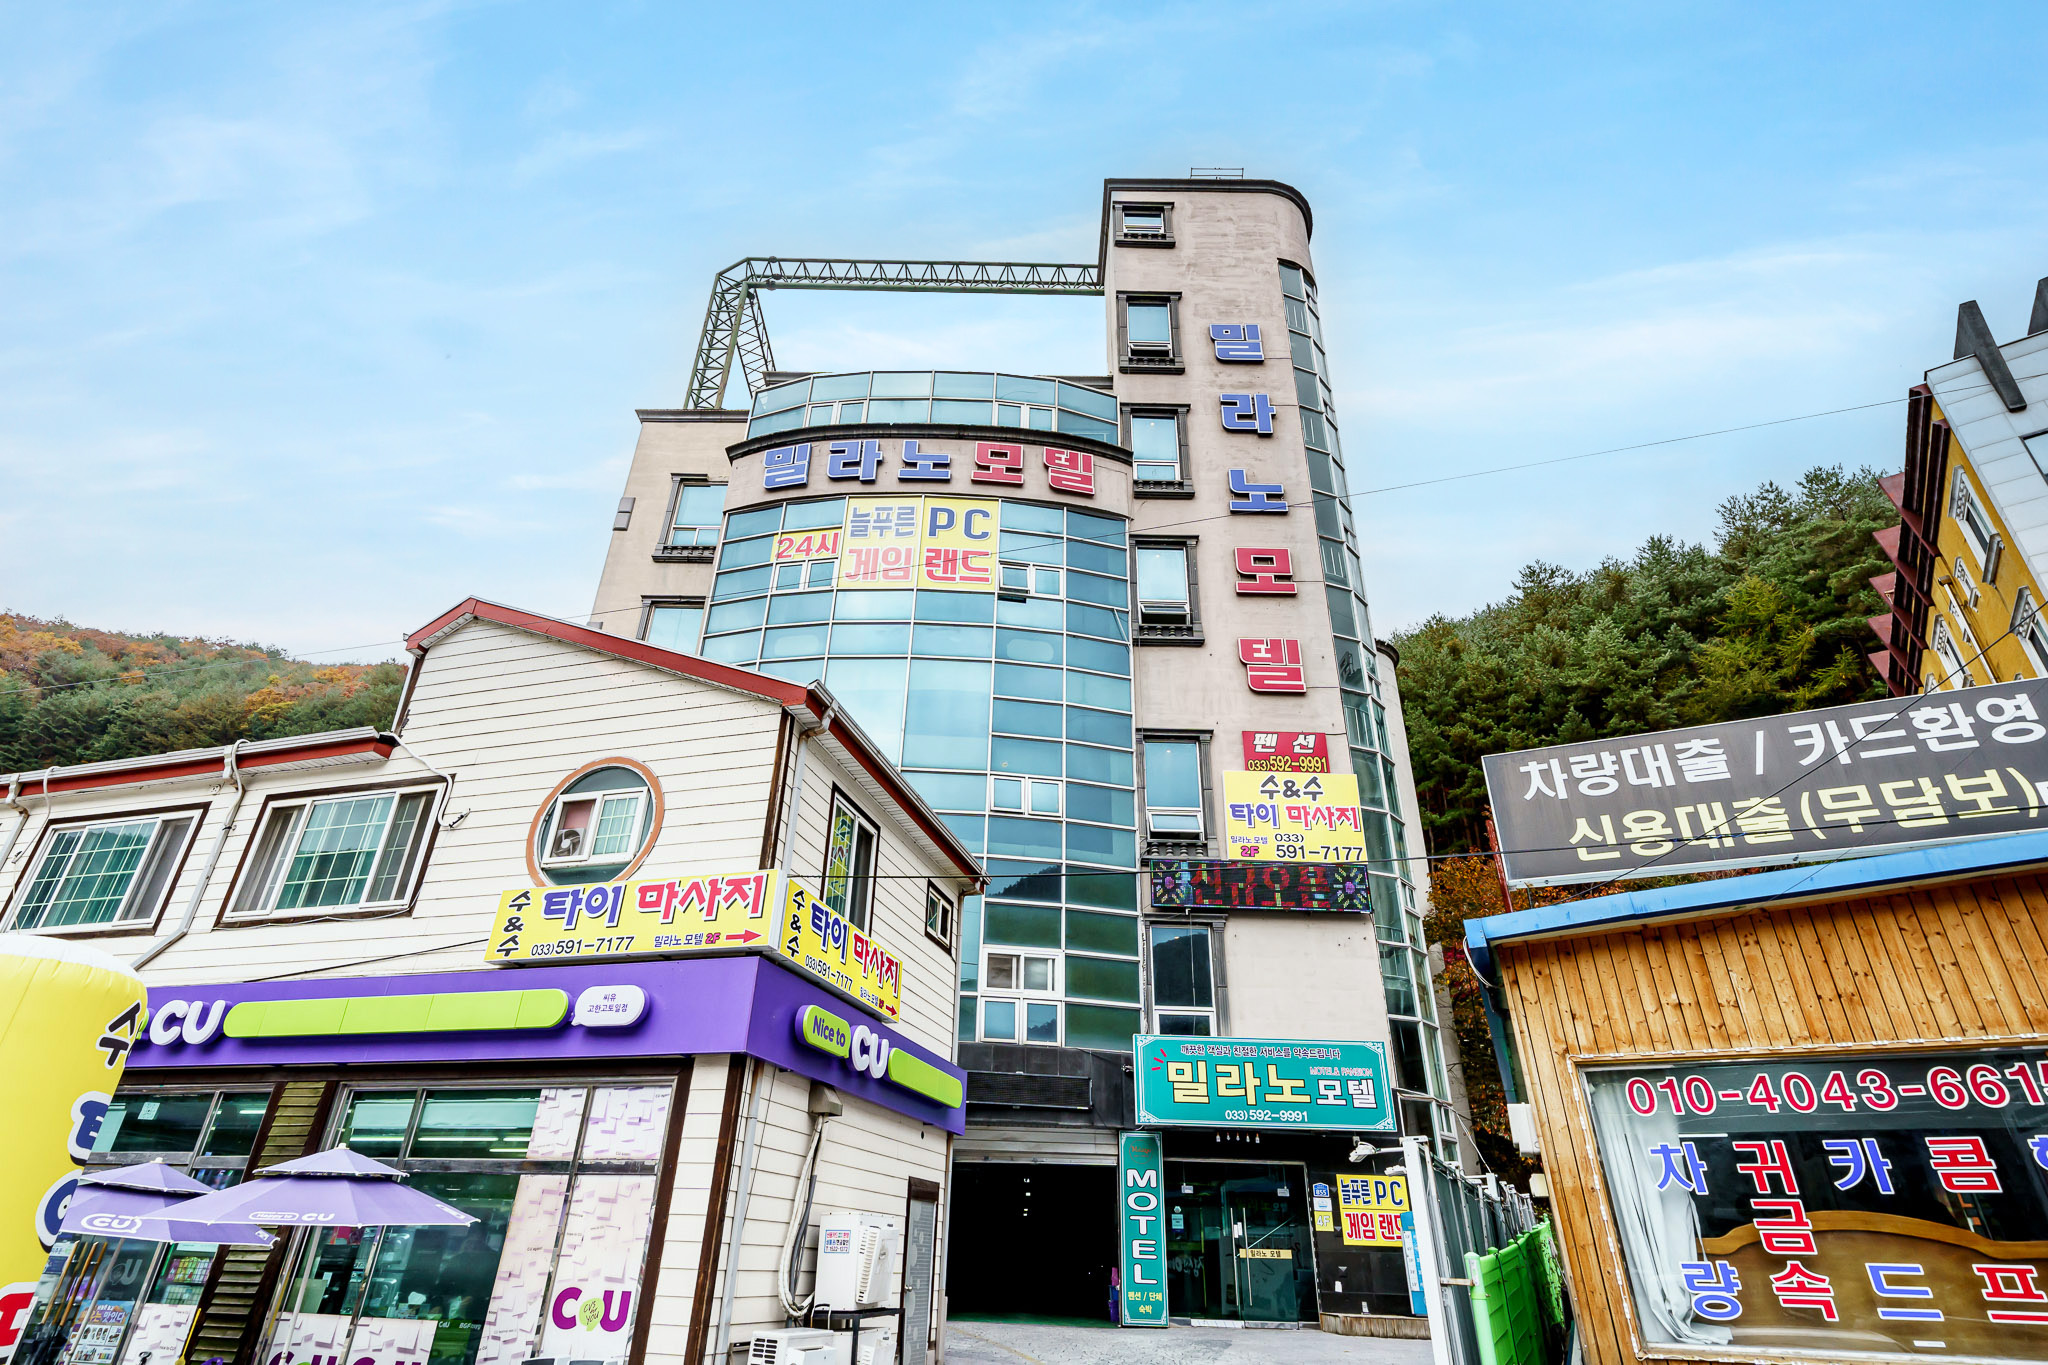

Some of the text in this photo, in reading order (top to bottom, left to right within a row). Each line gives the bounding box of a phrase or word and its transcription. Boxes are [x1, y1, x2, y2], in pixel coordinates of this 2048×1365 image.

[762, 439, 1096, 495] 밀라노 모텔
[849, 505, 991, 540] 늘푸른 PC
[1209, 323, 1307, 693] 밀라노 모텔
[773, 531, 841, 560] 24시
[844, 545, 991, 583] 게임 랜드
[1519, 738, 1732, 801] 차량대출
[1788, 693, 2047, 766] 카드환영
[1260, 775, 1324, 801] 수&수
[1229, 804, 1362, 832] 타이 마사지
[1240, 846, 1260, 858] 2F
[1274, 833, 1305, 843] 033)
[1276, 844, 1364, 861] 591-7177
[541, 873, 769, 930] 타이 마사지
[496, 890, 532, 957] 수&수
[531, 936, 635, 957] 033)591-7177
[654, 932, 721, 948] 밀라노 모텔 2F
[809, 900, 901, 999] 타이 마사지
[150, 1000, 226, 1046] CU
[813, 1015, 890, 1080] Nice to CU
[1167, 1060, 1378, 1109] 밀라노 모텔
[1340, 1178, 1404, 1207] 늘푸른 PC
[93, 1218, 131, 1229] CU
[301, 1213, 336, 1222] CU
[1126, 1168, 1159, 1285] MOTEL
[1316, 1215, 1331, 1227] 4F
[1344, 1212, 1377, 1241] 게임
